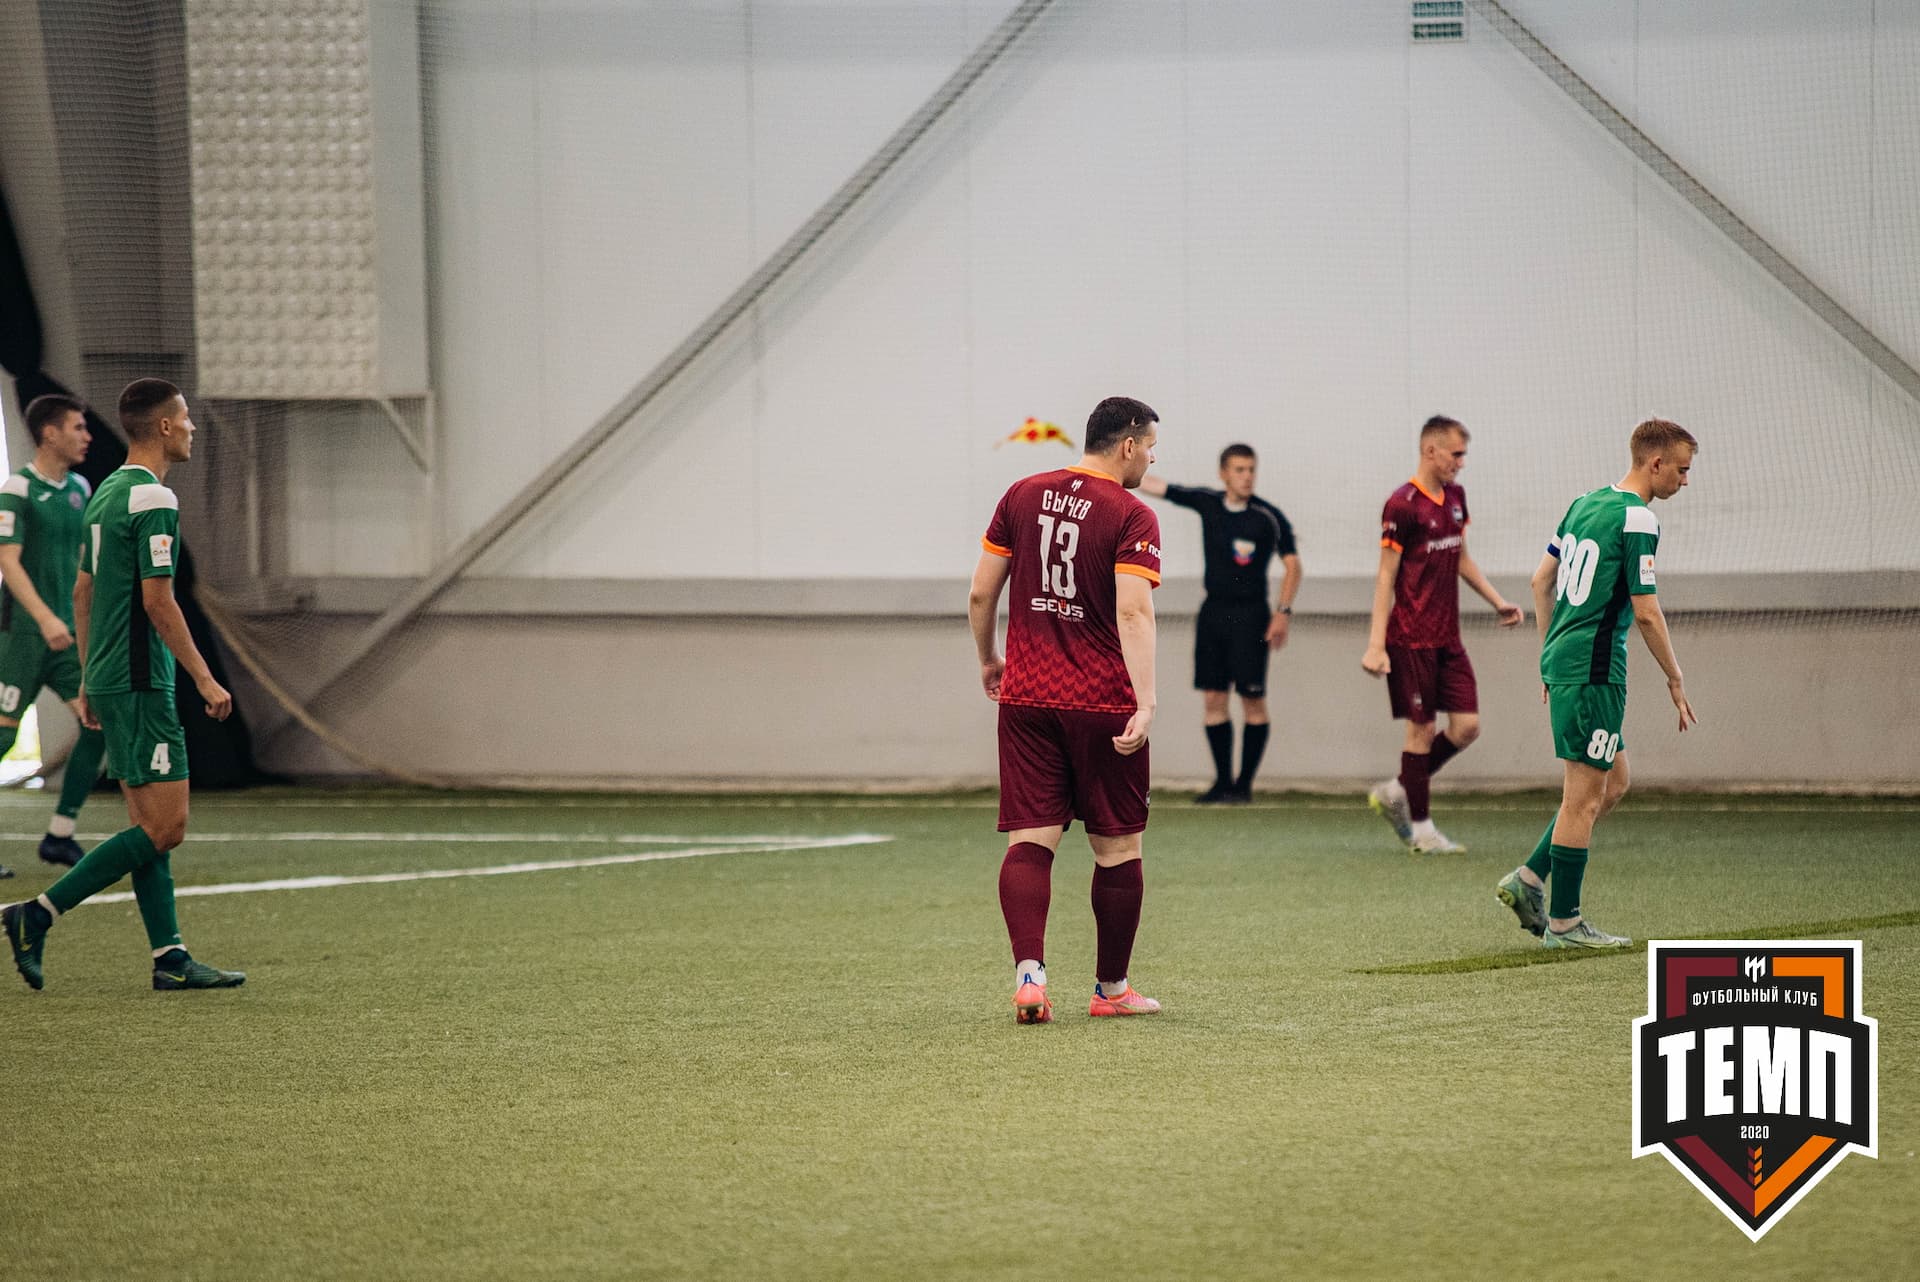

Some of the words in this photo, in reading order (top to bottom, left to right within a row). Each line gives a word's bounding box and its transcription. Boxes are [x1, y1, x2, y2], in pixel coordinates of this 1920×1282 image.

[1041, 488, 1092, 520] СЫЧЕВ
[1037, 513, 1080, 599] 13
[1556, 532, 1600, 607] 80
[1030, 597, 1084, 619] SEUS
[150, 742, 172, 775] 4
[1586, 728, 1620, 763] 80
